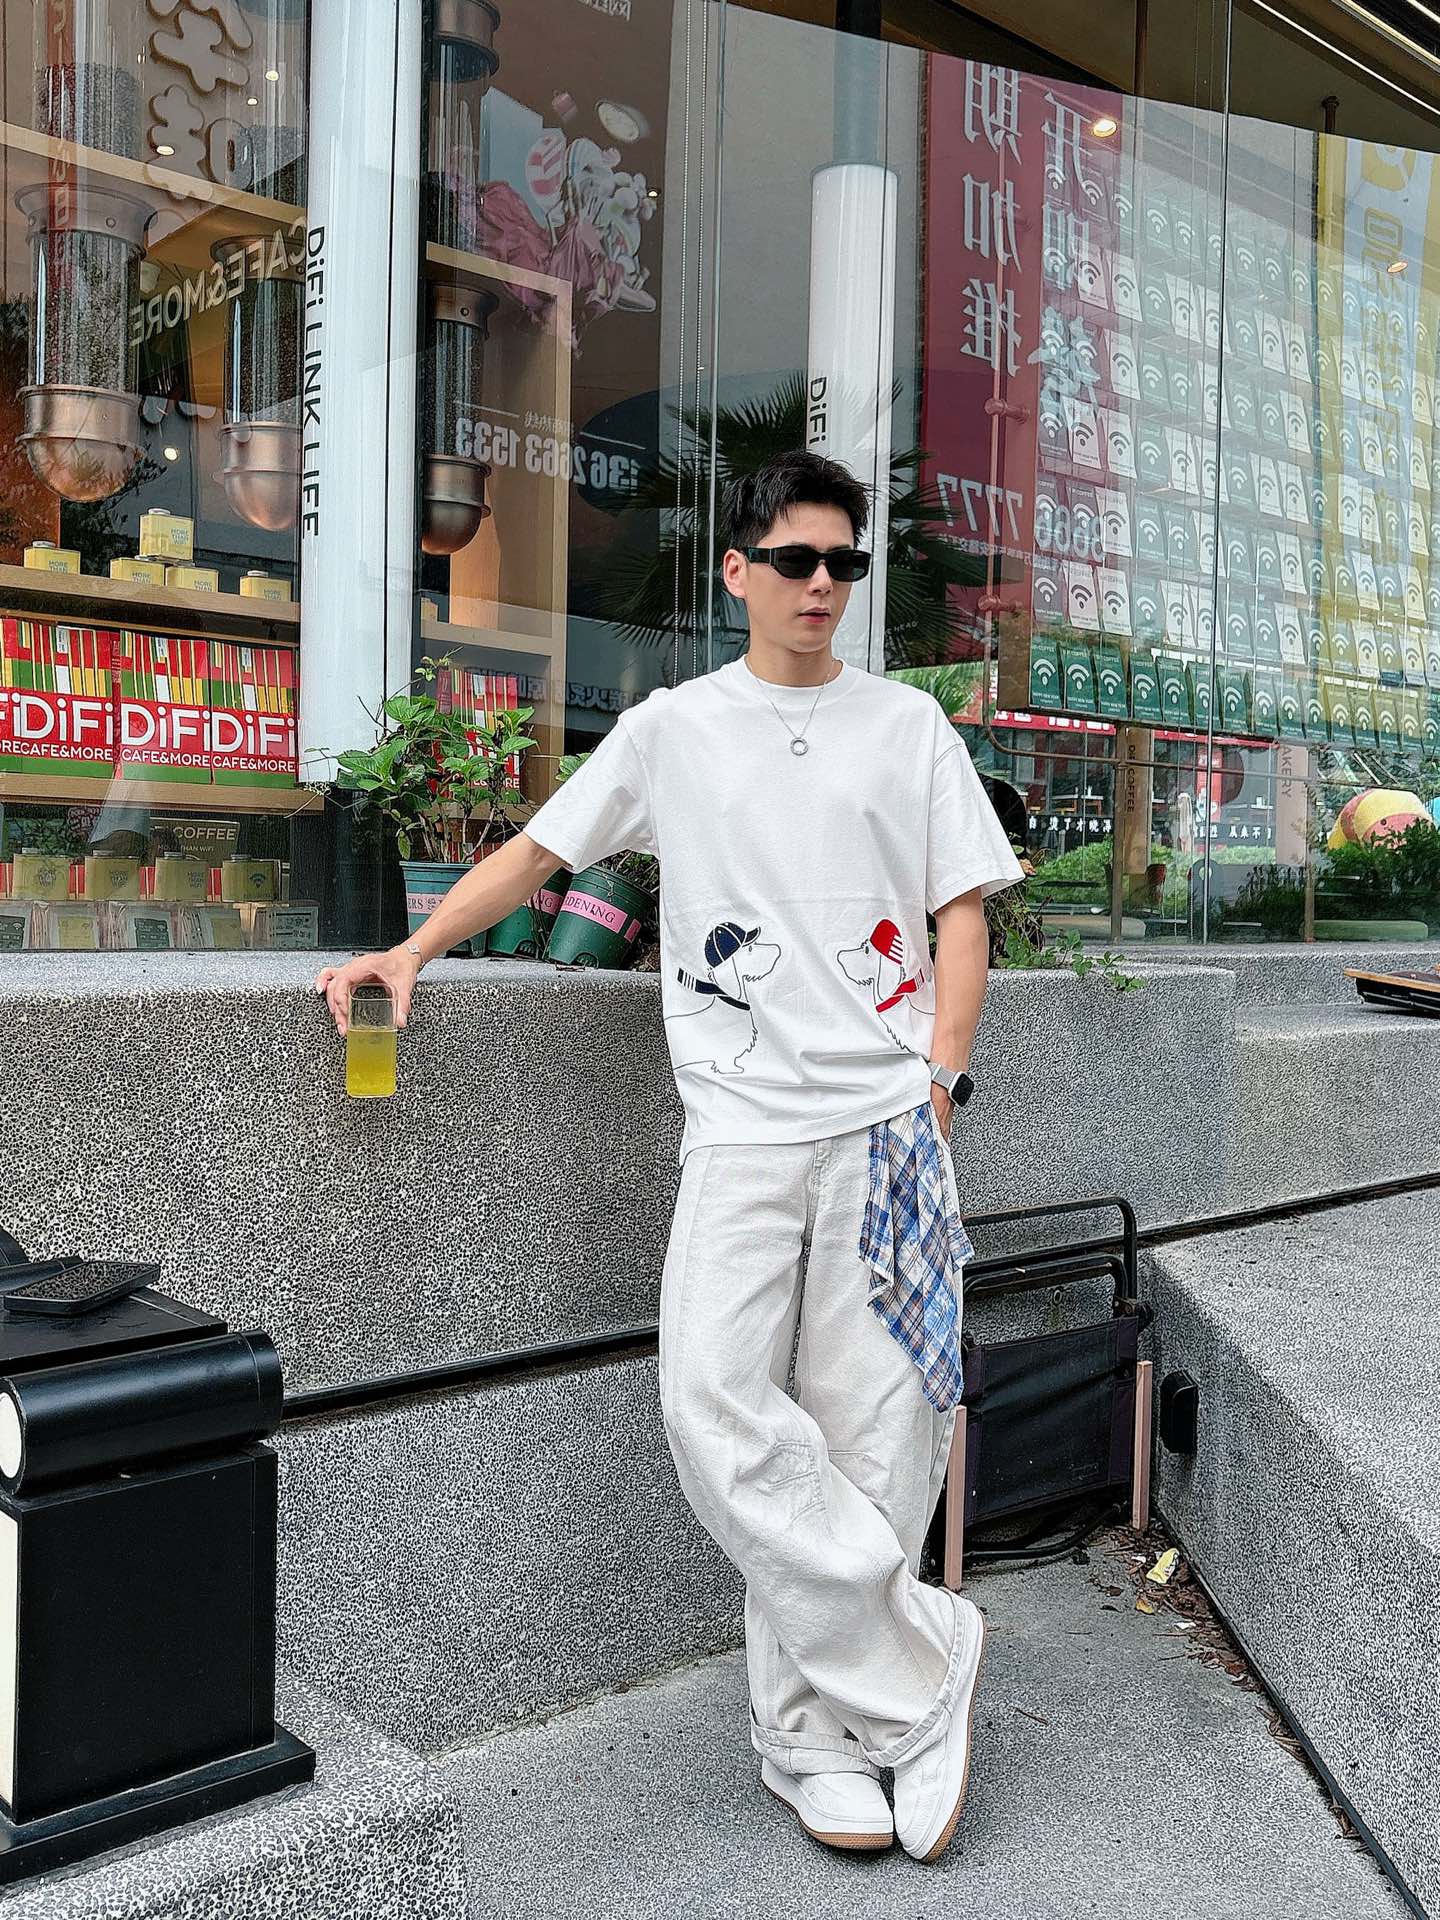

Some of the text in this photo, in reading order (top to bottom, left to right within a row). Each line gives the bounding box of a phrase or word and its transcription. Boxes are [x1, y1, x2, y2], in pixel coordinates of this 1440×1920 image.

[306, 226, 325, 309] DiFi
[303, 321, 322, 429] LINK
[809, 376, 827, 445] DiFi
[20, 693, 114, 745] DiFi
[120, 702, 211, 752] DiFi
[211, 711, 296, 758] DiFi
[20, 742, 114, 761] CAFE&MORE
[121, 748, 210, 768] CAFE&MORE
[212, 756, 296, 773] CAFE&MORE
[173, 826, 237, 840] COFFEE
